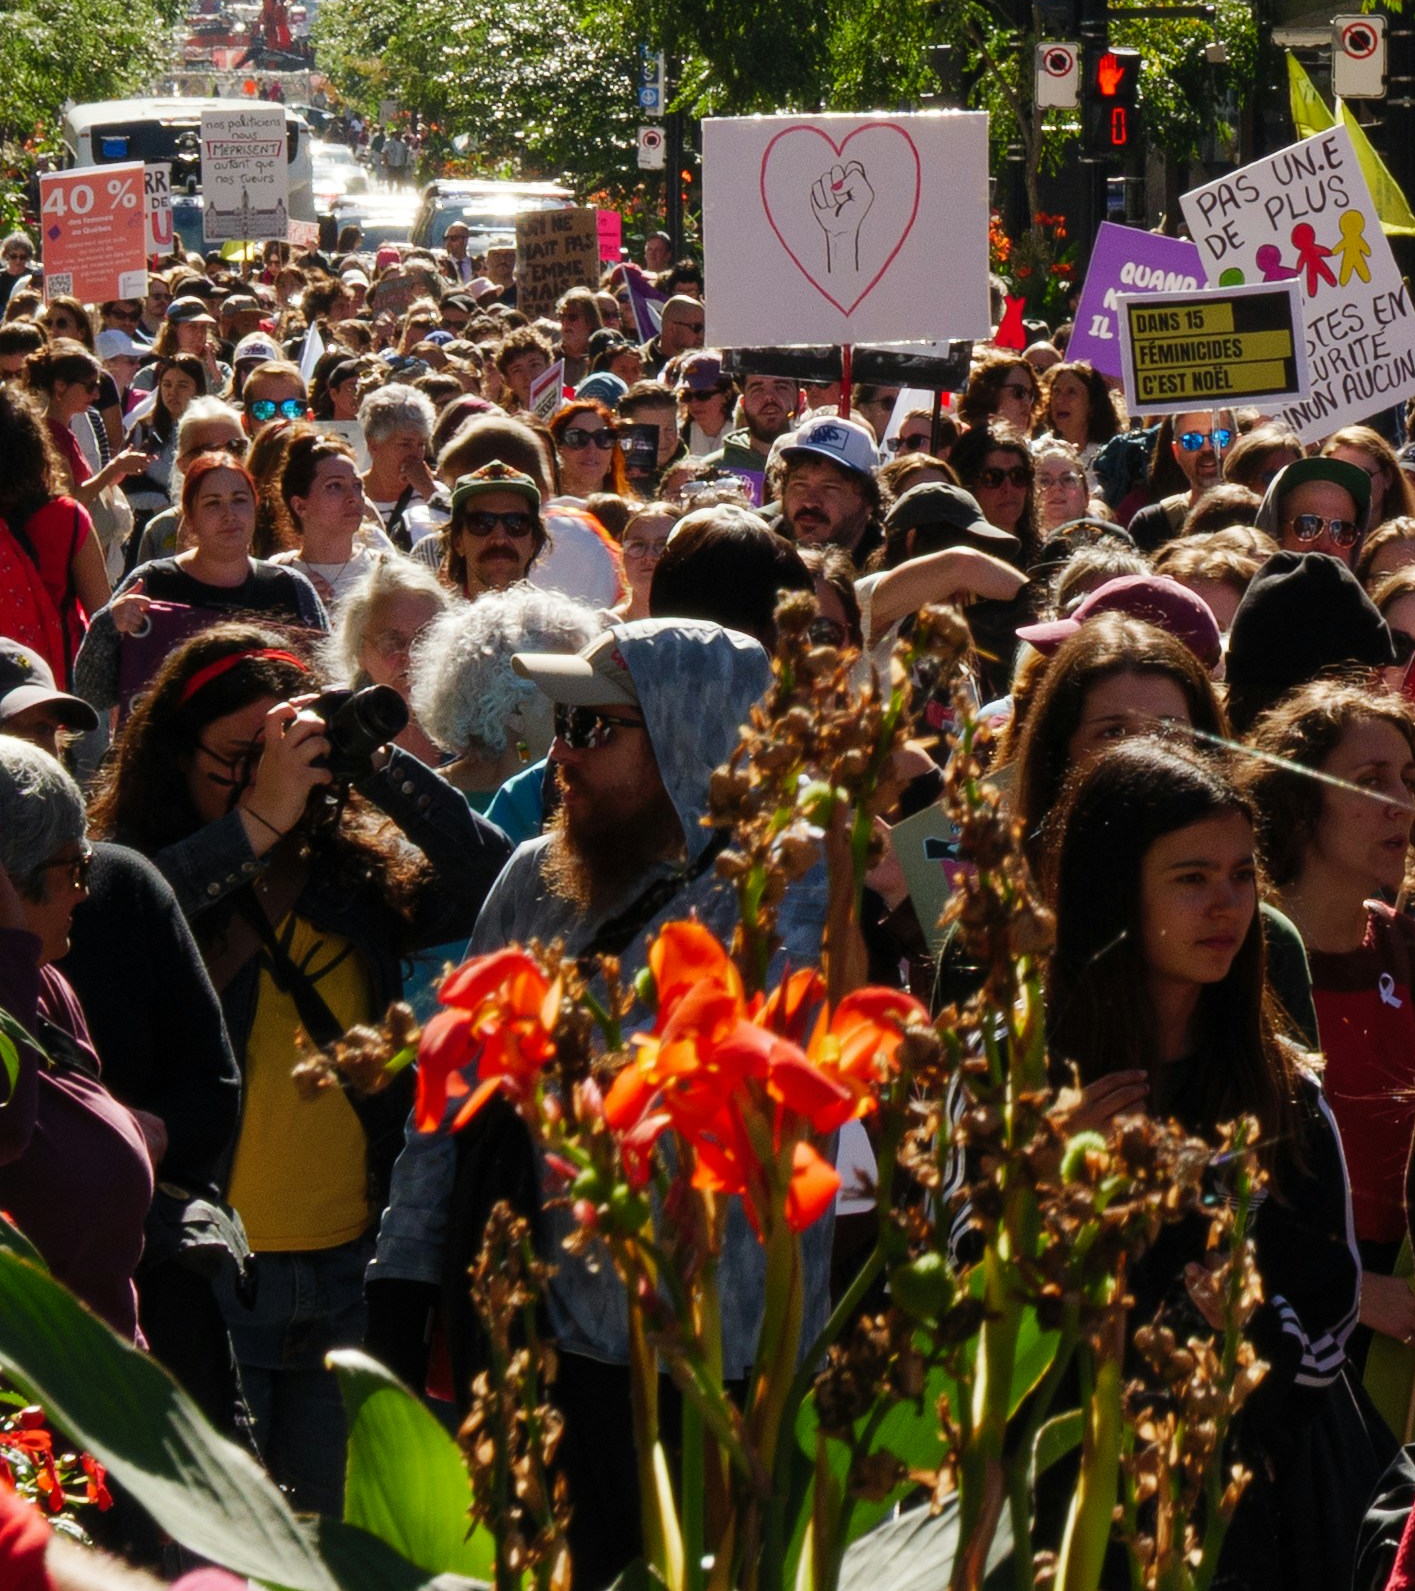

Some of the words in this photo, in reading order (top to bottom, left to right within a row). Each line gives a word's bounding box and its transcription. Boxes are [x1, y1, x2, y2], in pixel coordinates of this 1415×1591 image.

[255, 160, 276, 174] que
[43, 184, 95, 217] 40
[106, 178, 137, 209] %
[1196, 174, 1259, 227] PAS
[1204, 219, 1245, 261] DE
[1264, 174, 1351, 231] PLUS
[1136, 312, 1180, 334] DANS
[1184, 309, 1204, 330] 15
[1373, 285, 1408, 327] EN
[1139, 338, 1243, 365] FÉMINICIDES
[1142, 371, 1187, 396] C'EST
[1192, 365, 1233, 393] NOËL
